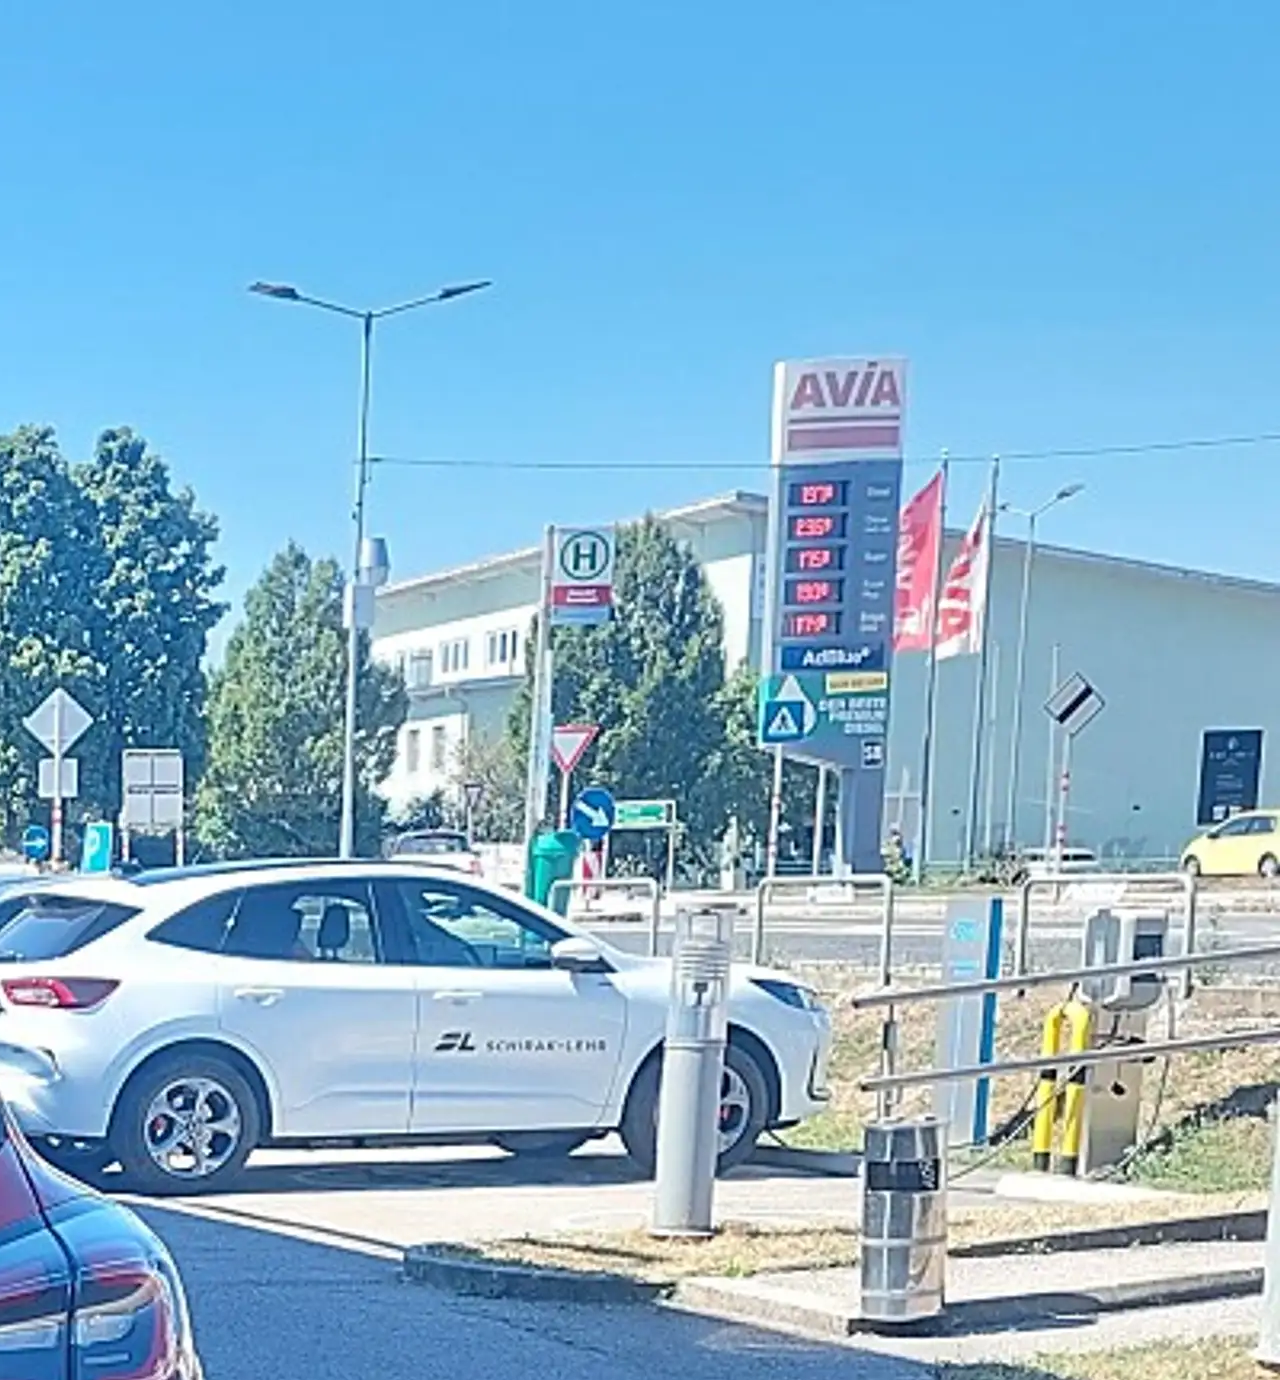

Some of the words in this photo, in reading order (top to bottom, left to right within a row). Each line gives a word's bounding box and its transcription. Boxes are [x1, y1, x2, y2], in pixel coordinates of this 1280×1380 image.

[790, 361, 901, 410] AVIA
[572, 541, 597, 571] H
[486, 1039, 607, 1051] SCHIRAK-LEHR
